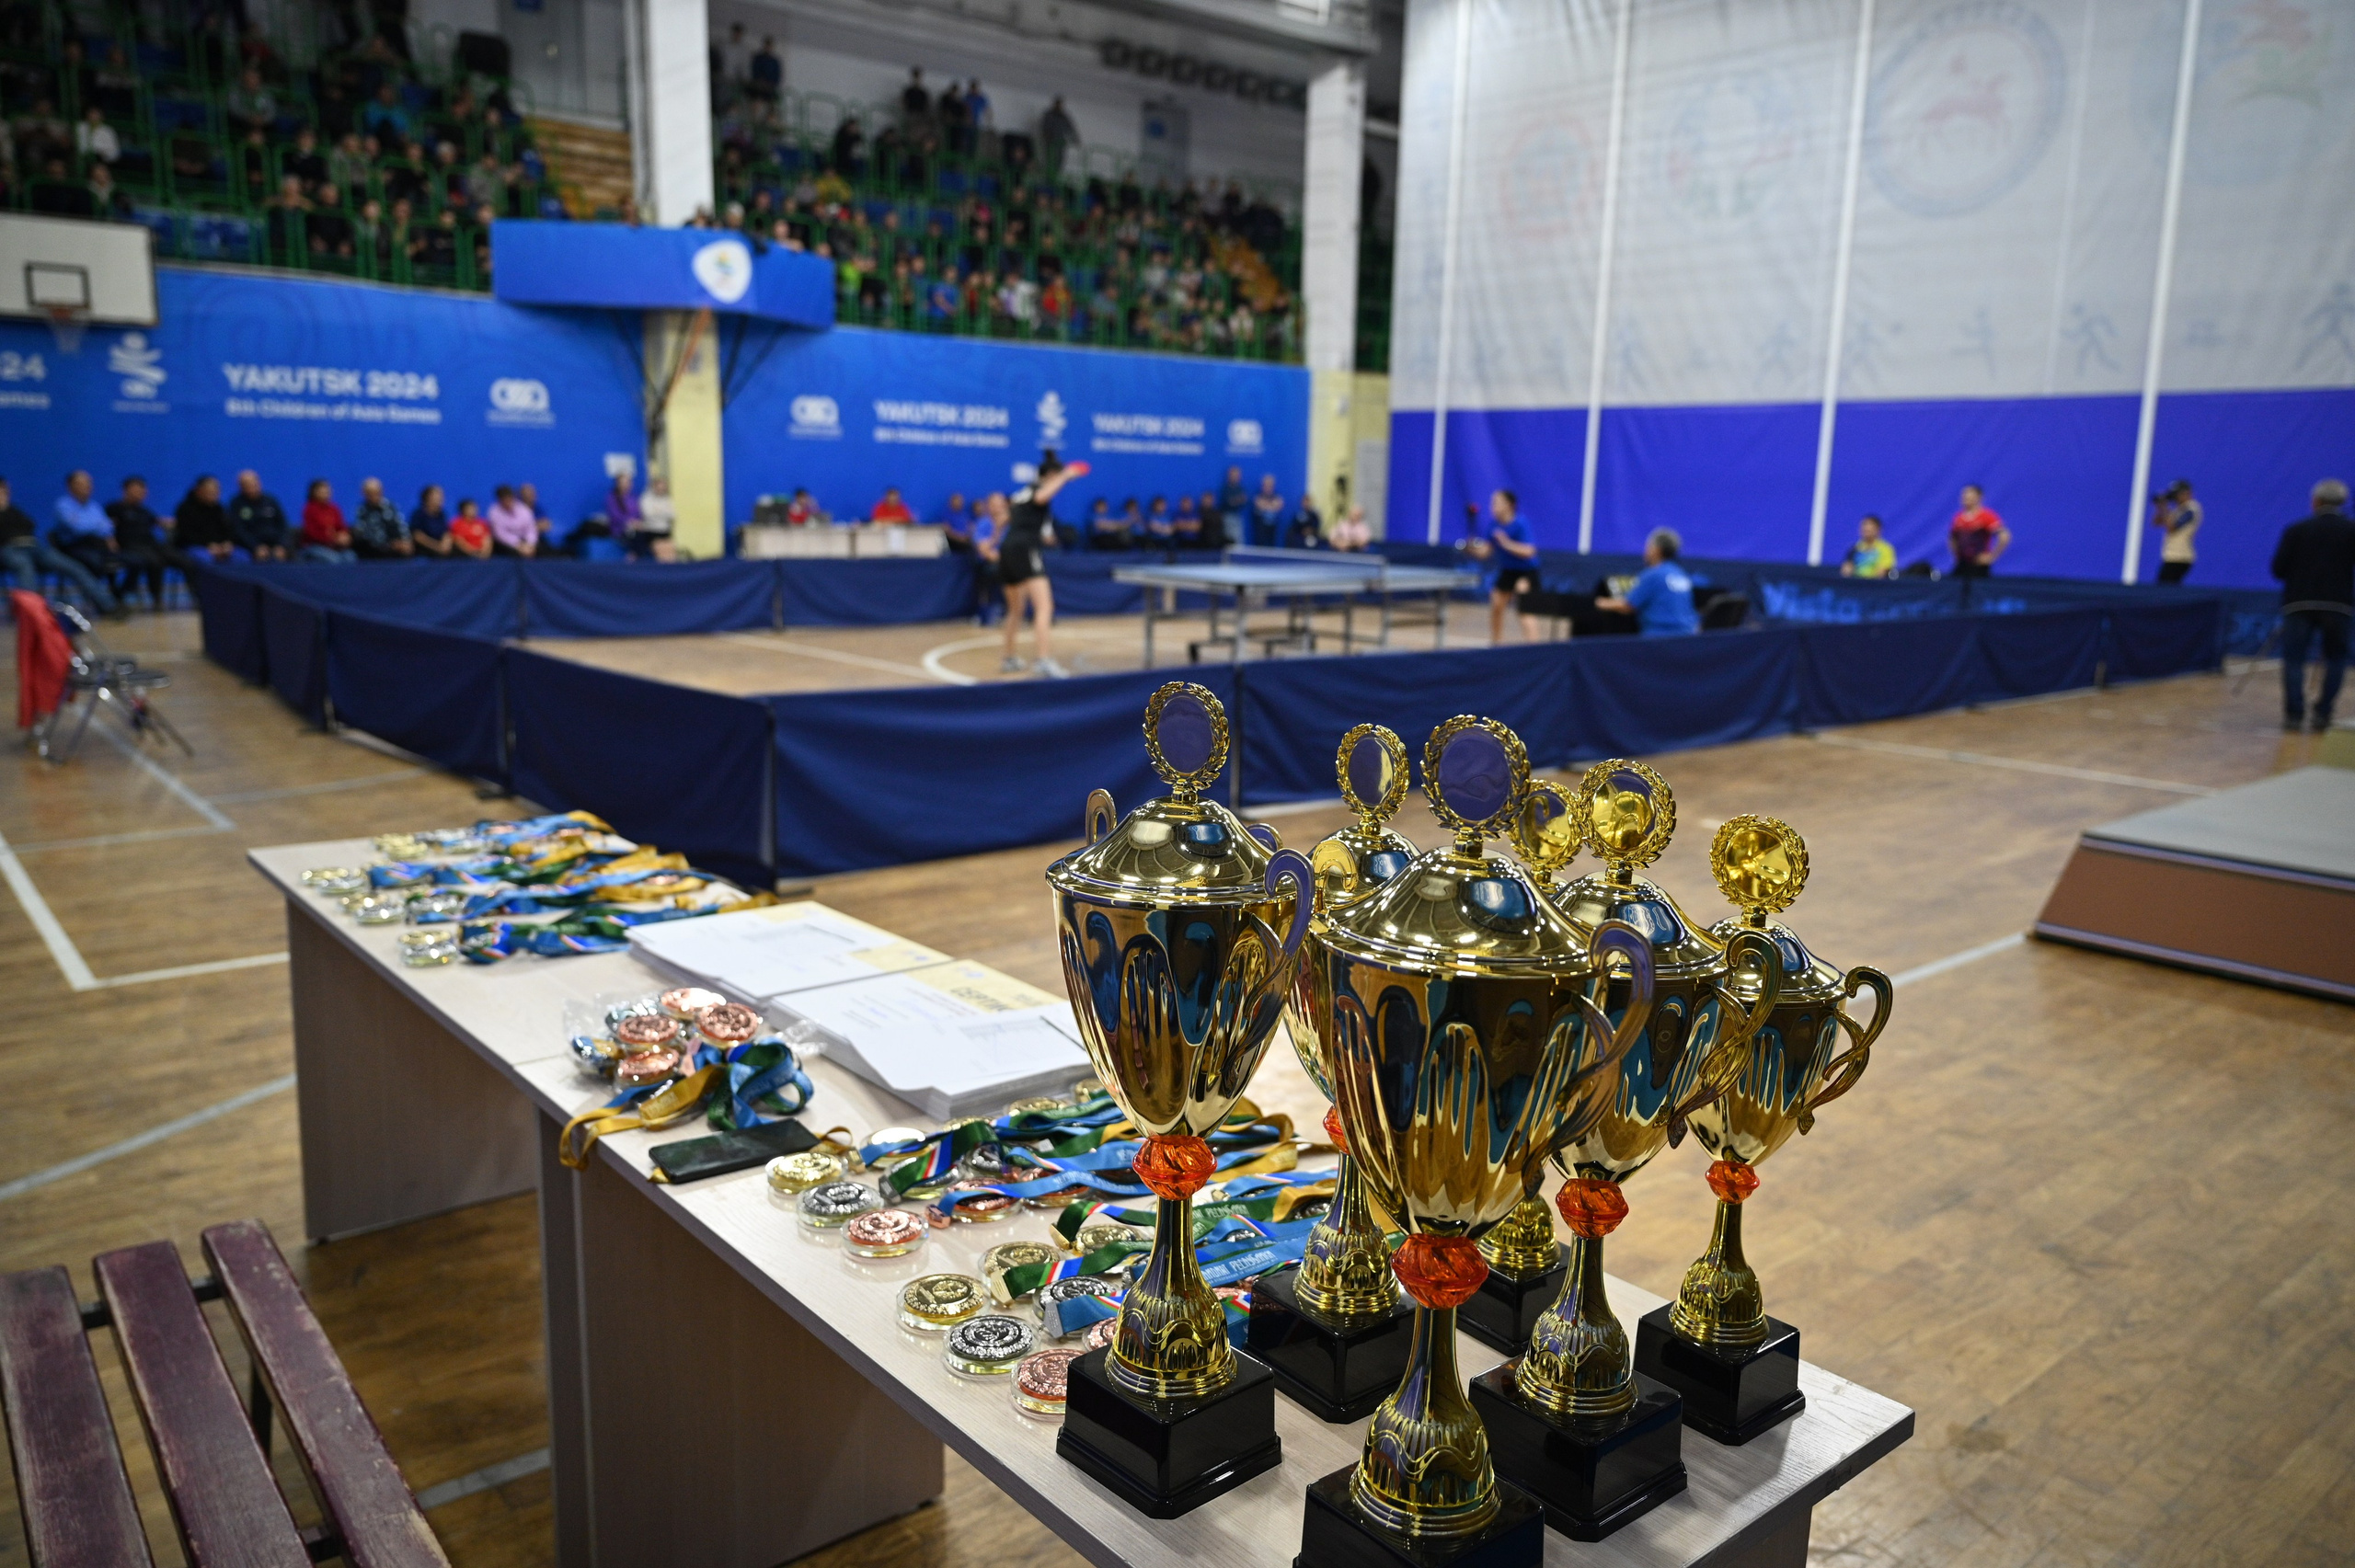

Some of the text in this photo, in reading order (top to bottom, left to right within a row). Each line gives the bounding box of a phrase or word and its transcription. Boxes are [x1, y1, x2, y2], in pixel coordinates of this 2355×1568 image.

[223, 363, 439, 399] YAKUTSK 2024
[874, 400, 959, 425] YAKUTSK
